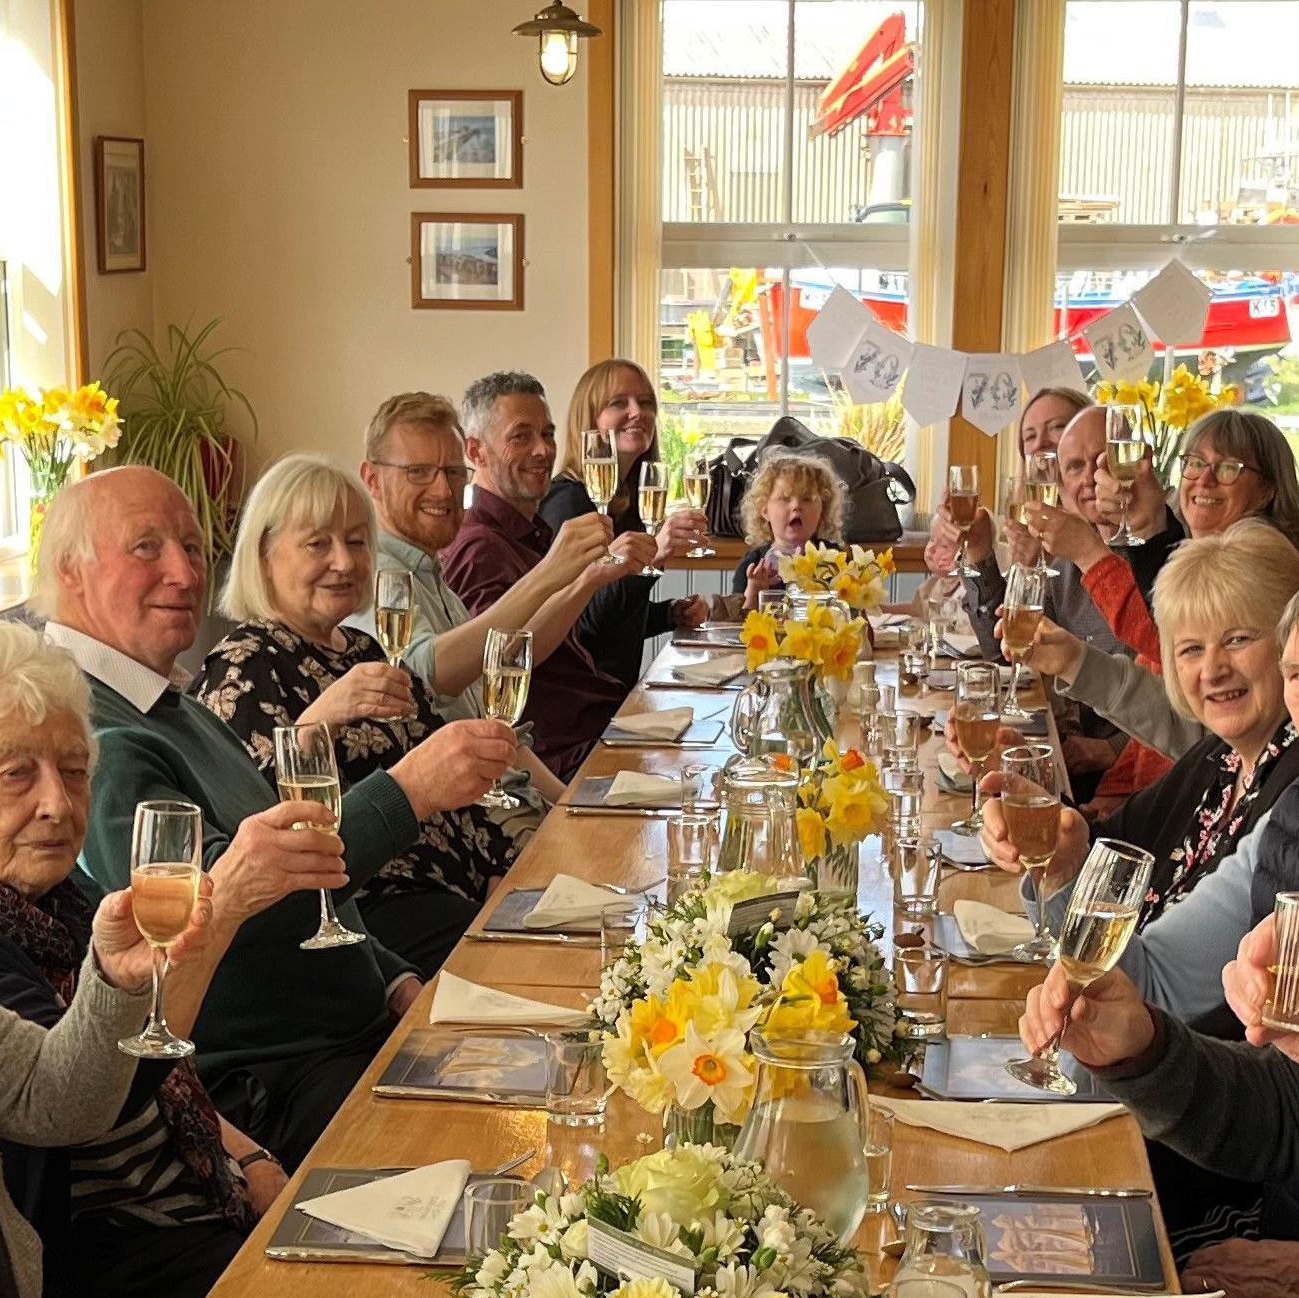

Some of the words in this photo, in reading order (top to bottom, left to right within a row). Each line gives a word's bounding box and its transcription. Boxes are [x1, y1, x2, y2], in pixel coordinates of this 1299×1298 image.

[854, 339, 901, 390] 70
[1094, 323, 1146, 371] 70
[966, 371, 1017, 410] 70
